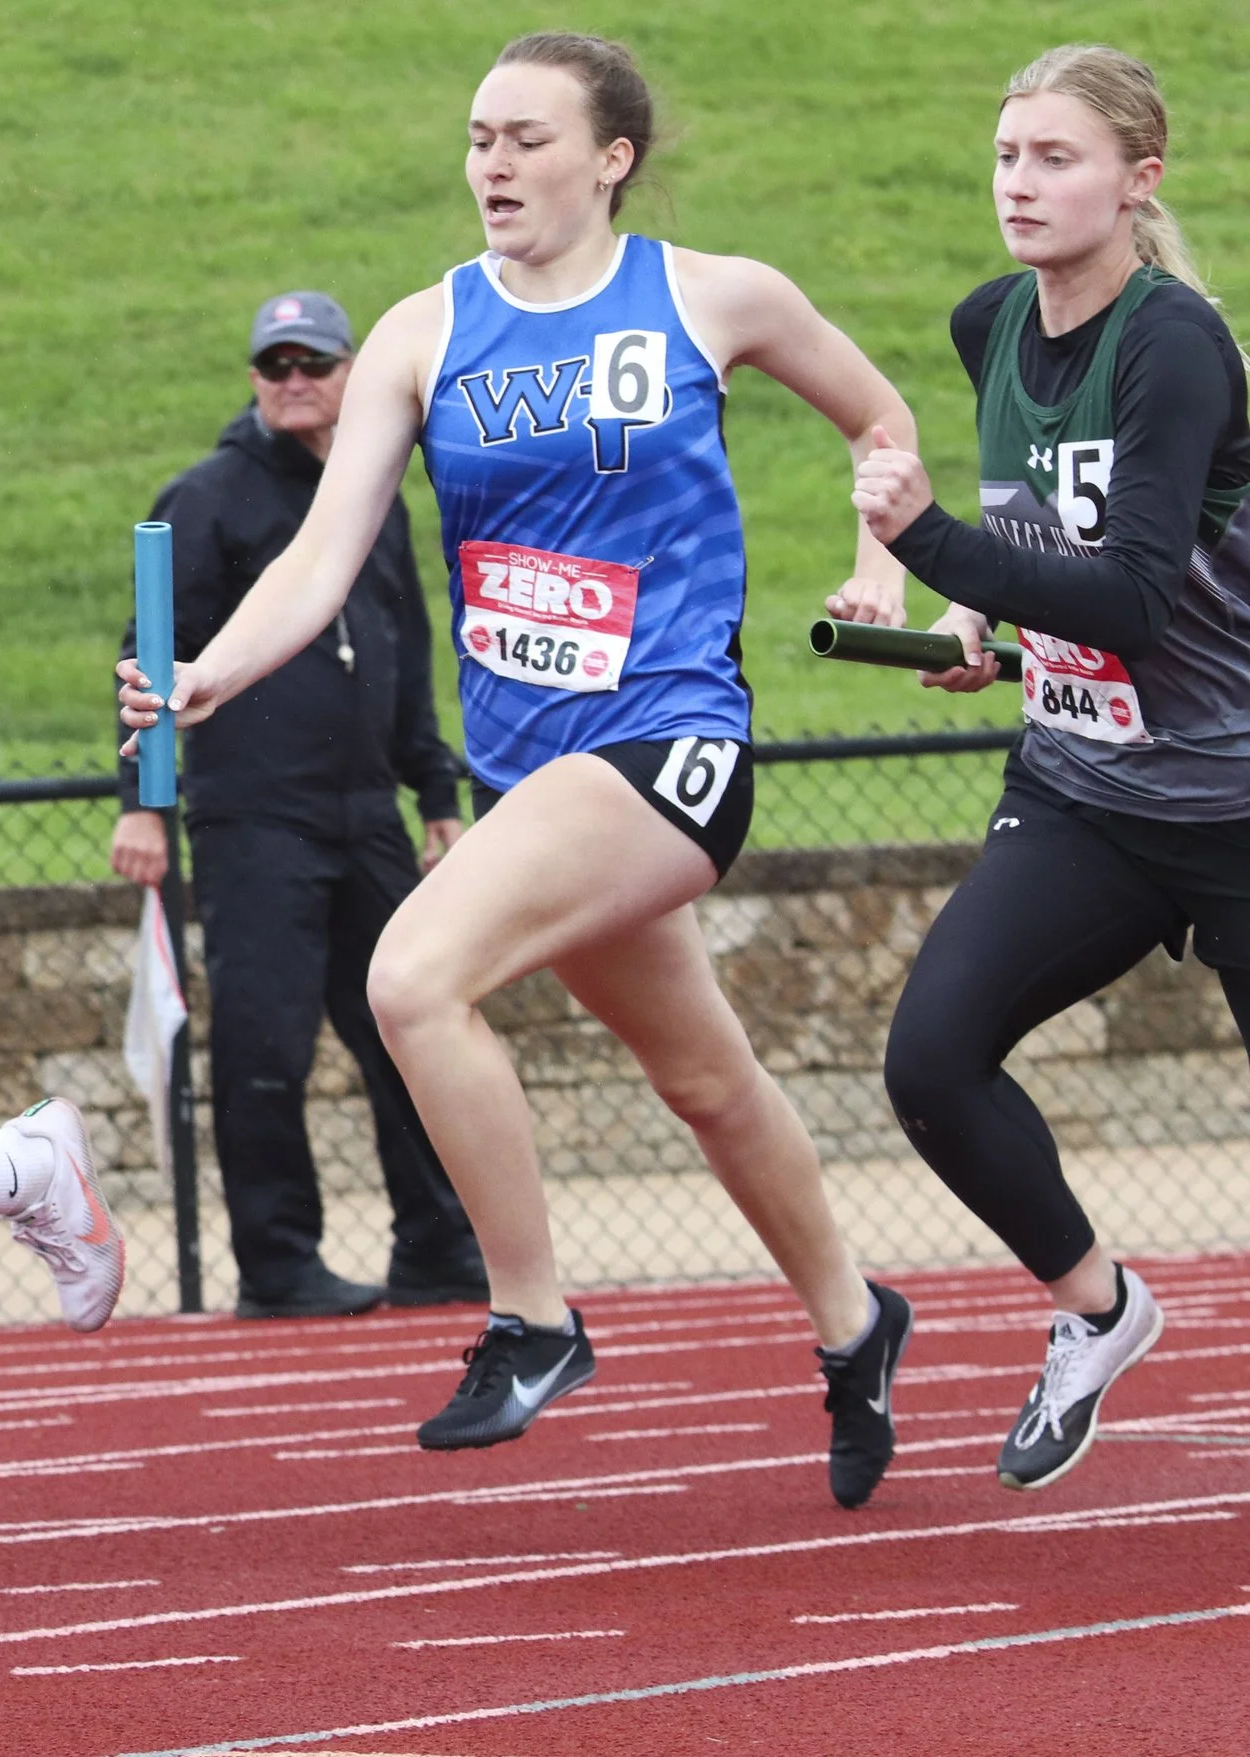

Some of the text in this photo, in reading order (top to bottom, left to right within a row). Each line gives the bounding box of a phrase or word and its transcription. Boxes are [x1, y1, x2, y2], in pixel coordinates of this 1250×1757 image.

[608, 334, 649, 413] 6
[1073, 448, 1107, 541] 5
[477, 561, 613, 620] ZERO
[509, 552, 582, 578] SHOW-ME
[496, 628, 580, 675] 1436
[1021, 627, 1105, 671] ERO
[1042, 679, 1099, 723] 844
[676, 738, 727, 807] 6
